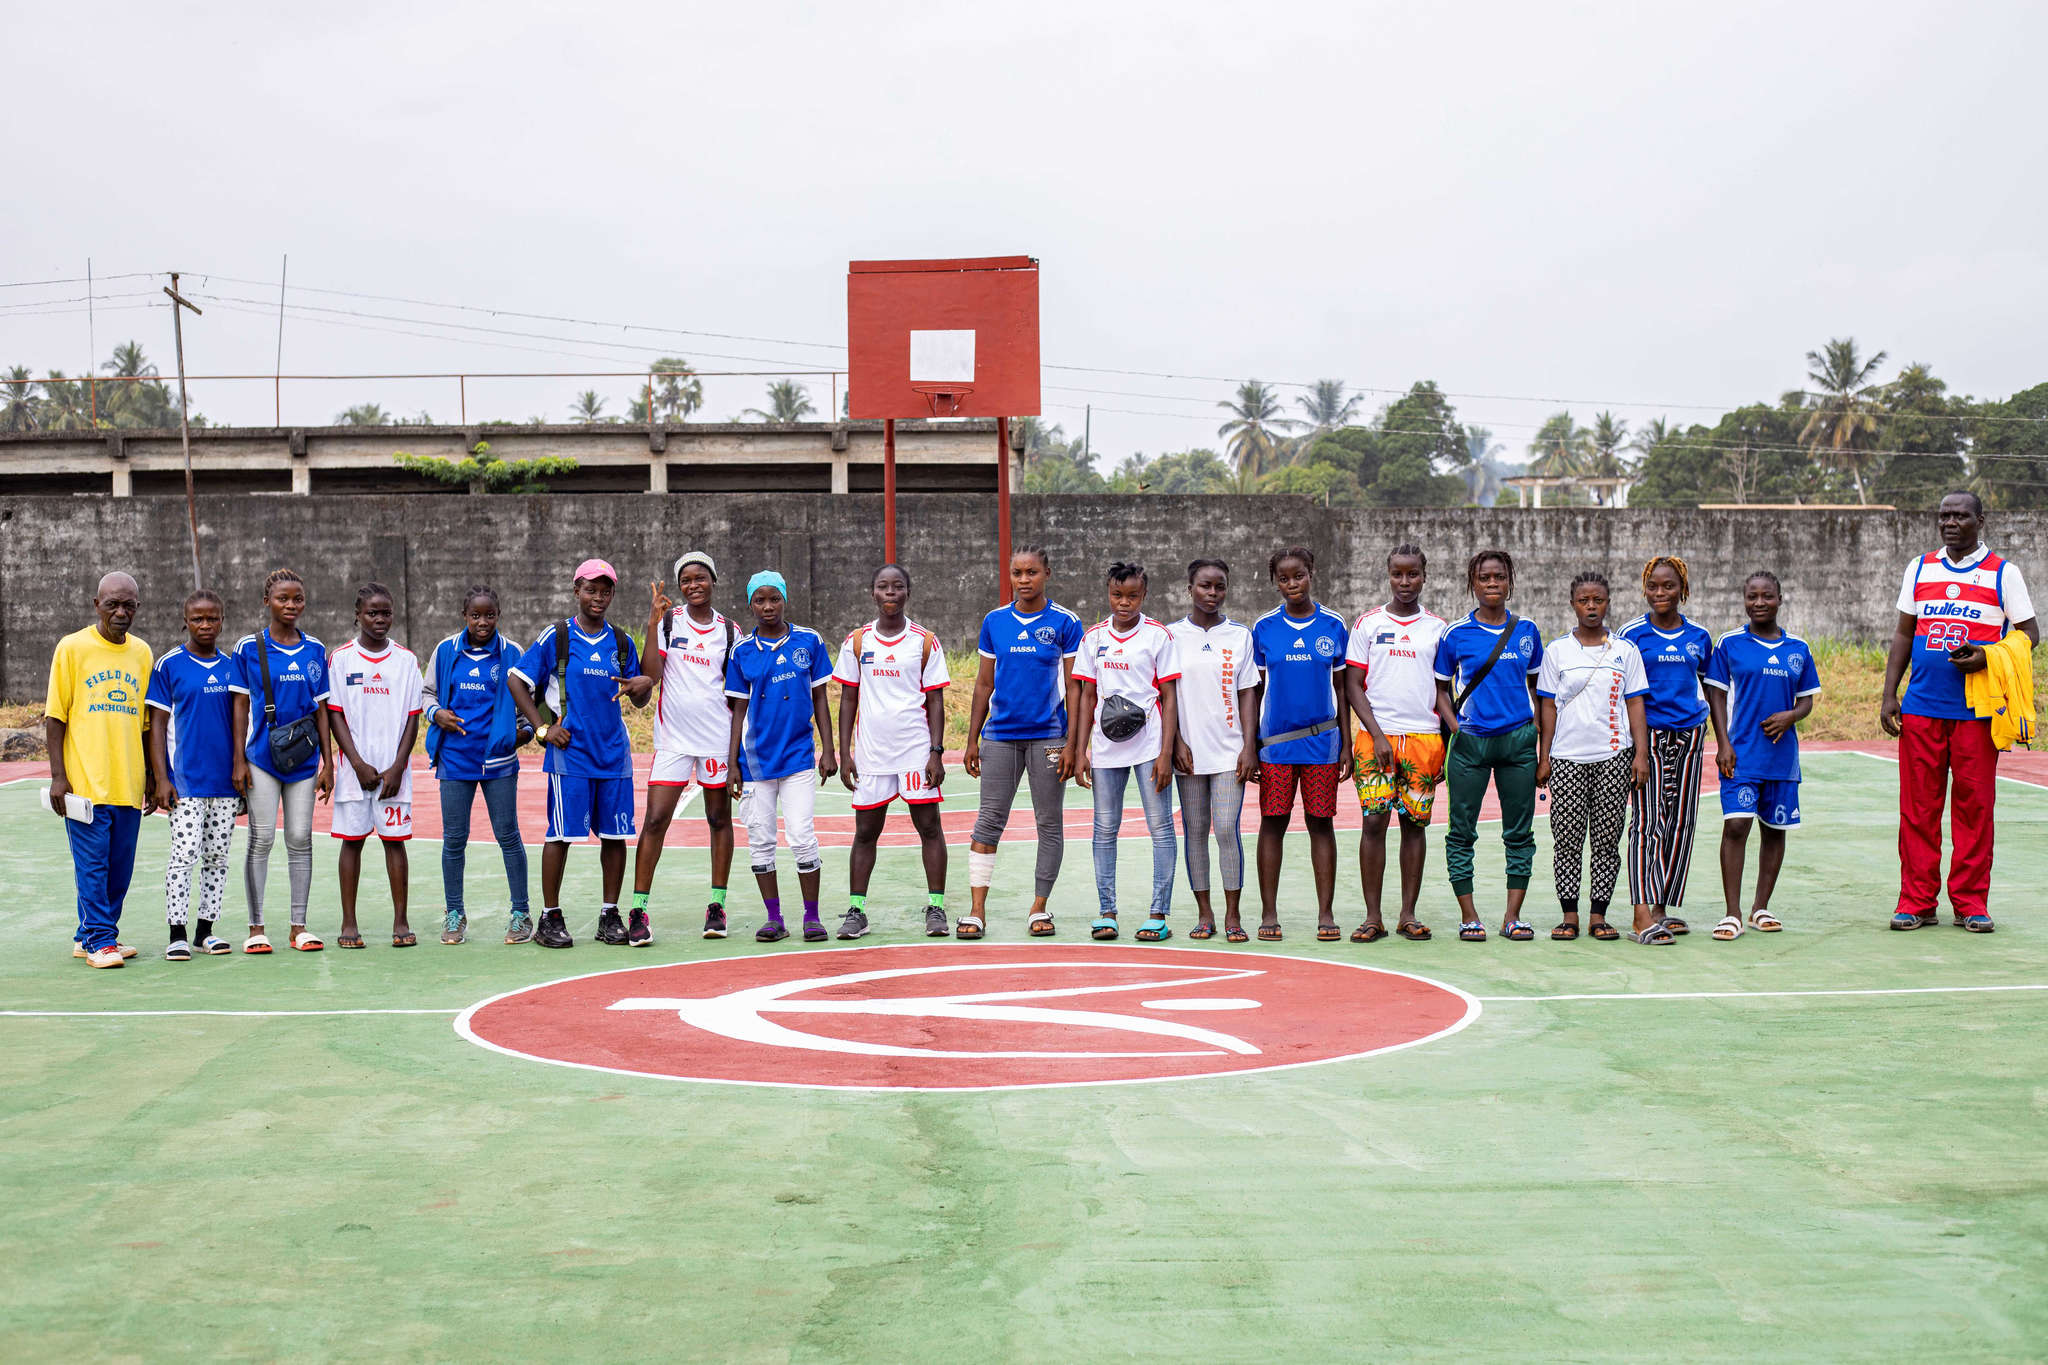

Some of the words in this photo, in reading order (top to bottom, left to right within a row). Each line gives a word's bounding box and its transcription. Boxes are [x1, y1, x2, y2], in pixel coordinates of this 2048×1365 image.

[1923, 602, 1982, 619] bullets
[1925, 622, 1969, 652] 23
[1010, 645, 1037, 653] BASSA
[1389, 649, 1416, 659] BASSA
[683, 653, 710, 666] BASSA
[1286, 653, 1312, 662] BASSA
[1658, 654, 1686, 663] BASSA
[1104, 661, 1129, 671] BASSA
[583, 667, 609, 677] BASSA
[872, 668, 900, 677] BASSA
[1763, 667, 1789, 677] BASSA
[85, 670, 121, 688] FIELD
[279, 673, 306, 682] BASSA
[772, 671, 797, 684] BASSA
[203, 685, 228, 694] BASSA
[363, 686, 390, 695] BASSA
[459, 682, 486, 691] BASSA
[88, 703, 138, 716] ANCHORAG
[705, 758, 718, 778] 9
[904, 771, 921, 791] 10
[385, 806, 402, 826] 21
[1774, 804, 1788, 825] 6
